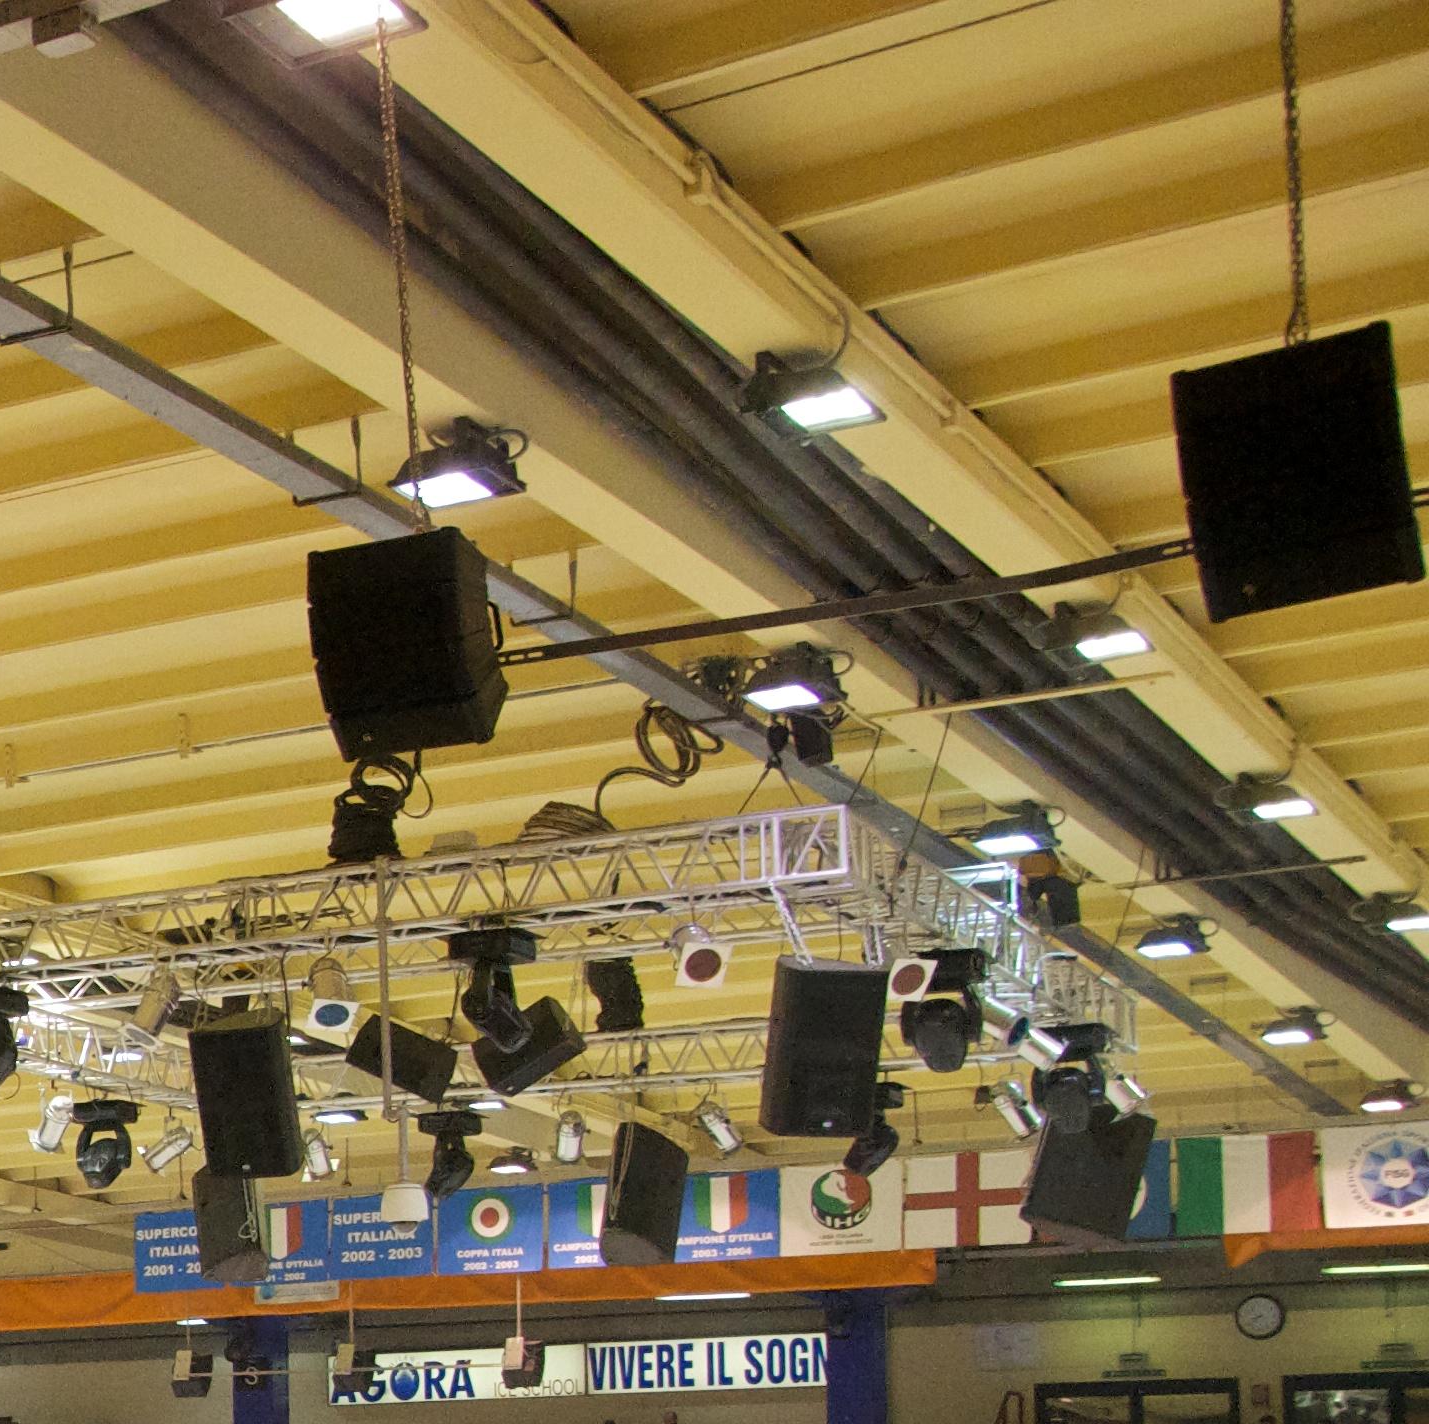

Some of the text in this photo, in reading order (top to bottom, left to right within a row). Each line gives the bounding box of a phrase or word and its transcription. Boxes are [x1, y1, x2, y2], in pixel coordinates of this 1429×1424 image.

[136, 1226, 198, 1241] SUPERCO
[677, 1234, 726, 1246] AMPIONE
[149, 1246, 200, 1258] ITALIAN
[457, 1246, 524, 1259] COPPA ITALIA
[553, 1241, 600, 1253] CAMPION
[341, 1250, 376, 1263] 2002
[388, 1246, 423, 1260] 2003
[144, 1264, 174, 1277] 2001
[186, 1261, 202, 1274] 20
[589, 1343, 695, 1390] VIVERE
[706, 1341, 733, 1385] IL
[743, 1336, 828, 1385] SOGN
